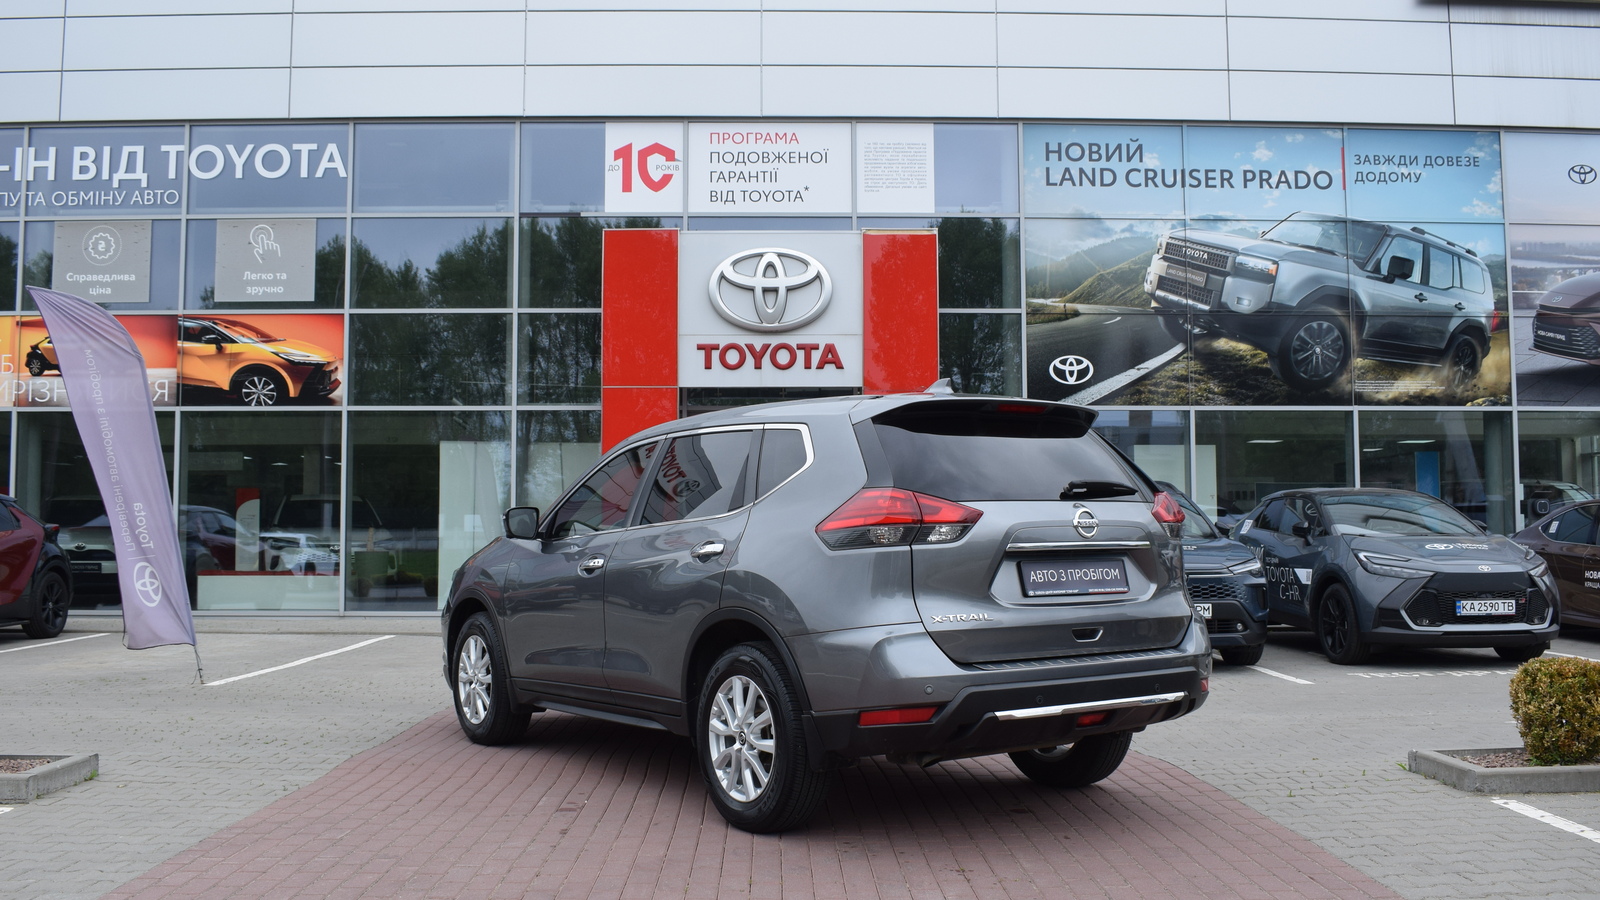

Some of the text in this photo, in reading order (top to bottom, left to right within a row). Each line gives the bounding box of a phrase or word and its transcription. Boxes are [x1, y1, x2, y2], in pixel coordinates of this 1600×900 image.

[709, 132, 800, 145] ПРОГРАМА
[709, 149, 829, 166] ПОДОВЖЕНОЇ
[1044, 138, 1144, 164] НОВИЙ
[72, 145, 148, 188] ВІД
[161, 142, 348, 180] TOYOTA
[655, 164, 680, 172] РОКІВ
[1353, 153, 1481, 170] ЗАВЖДИ ДОВЕЗЕ
[709, 168, 778, 183] ГАРАНТІЇ
[1044, 166, 1334, 191] LAND CRUISER PRADO
[1353, 169, 1423, 185] ДОДОМУ
[26, 191, 46, 206] ТА
[51, 190, 126, 206] ОБМІНУ
[130, 189, 180, 205] АВТО
[709, 190, 736, 205] ВІД
[1182, 247, 1208, 260] TOYOTA
[66, 272, 136, 283] Справедлива
[243, 271, 287, 281] Легко та
[89, 285, 112, 295] ціна
[246, 285, 284, 295] зручно
[696, 342, 845, 370] TOYOTA
[1030, 569, 1058, 583] АВТО
[1067, 568, 1121, 581] ПРОБІГОМ
[1266, 566, 1296, 583] TOYOTA
[1280, 583, 1302, 601] C-HR
[1461, 601, 1515, 612] KA 2590 TB
[930, 612, 994, 624] X-TRAIL
